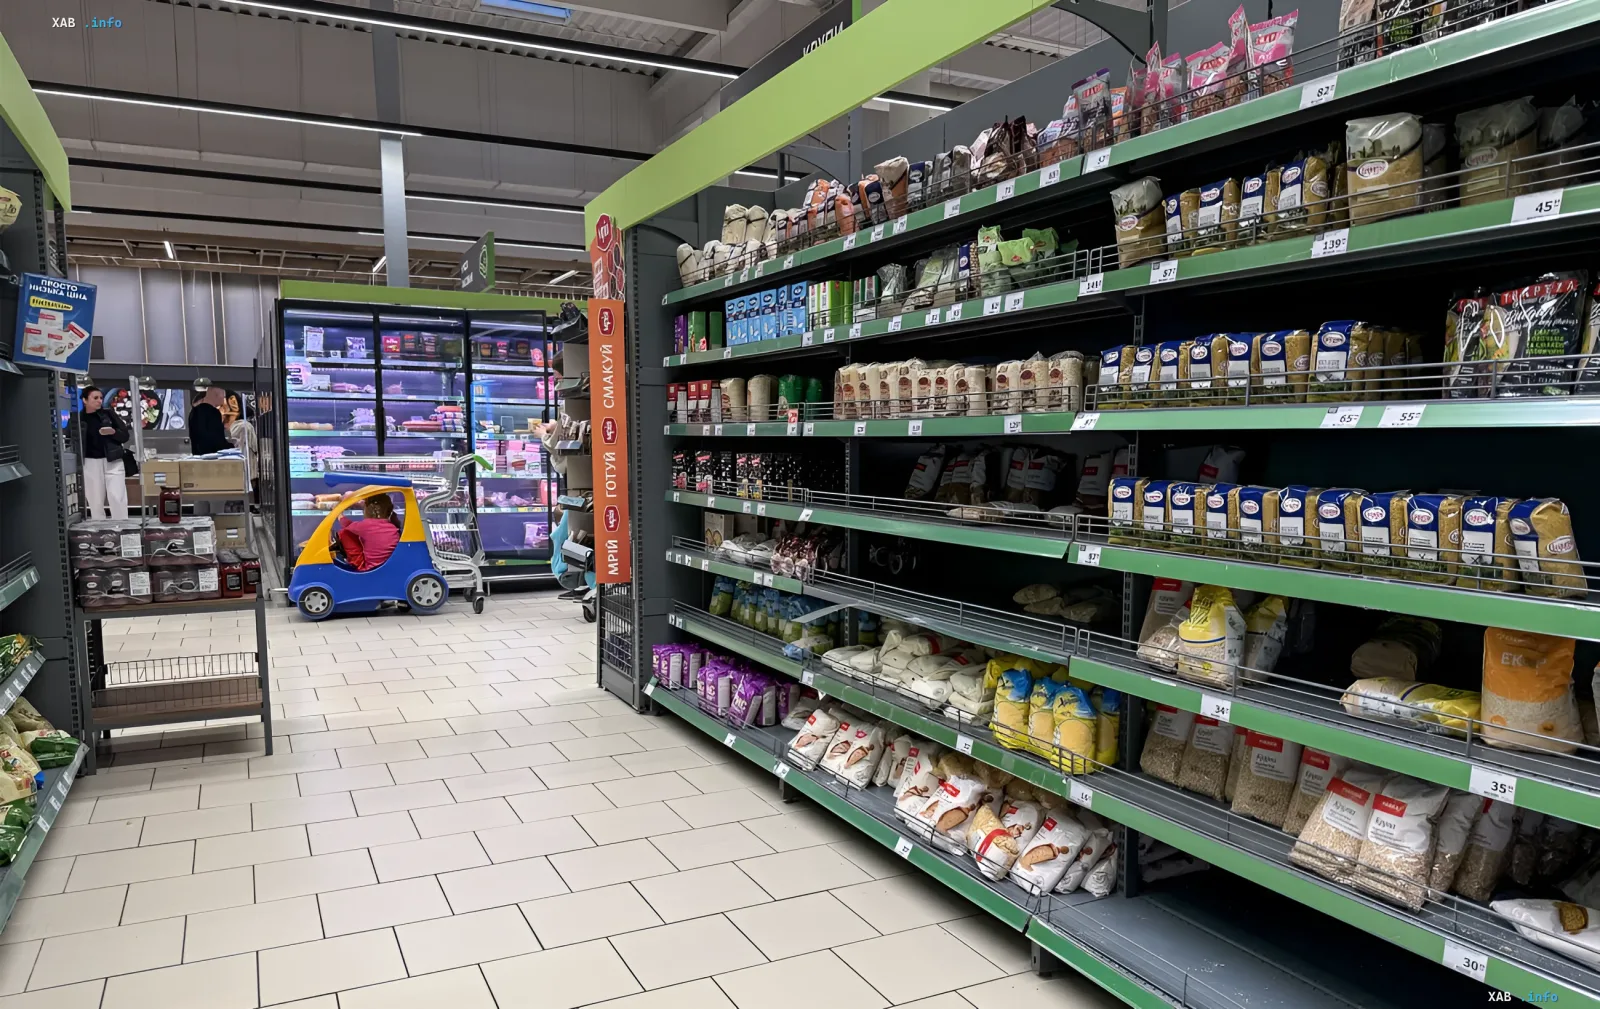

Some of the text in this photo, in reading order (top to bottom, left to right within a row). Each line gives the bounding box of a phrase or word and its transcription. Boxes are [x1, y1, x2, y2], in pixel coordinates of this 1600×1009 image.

[1535, 200, 1553, 213] 45
[1323, 238, 1342, 250] 139
[41, 279, 78, 292] ПРОСТО
[66, 291, 88, 301] ЦІНА
[600, 344, 614, 409] СМАКУЙ
[603, 452, 617, 498] ГОТУЙ
[605, 539, 619, 575] МРІЙ
[1491, 780, 1507, 794] 35
[1462, 957, 1478, 971] 30
